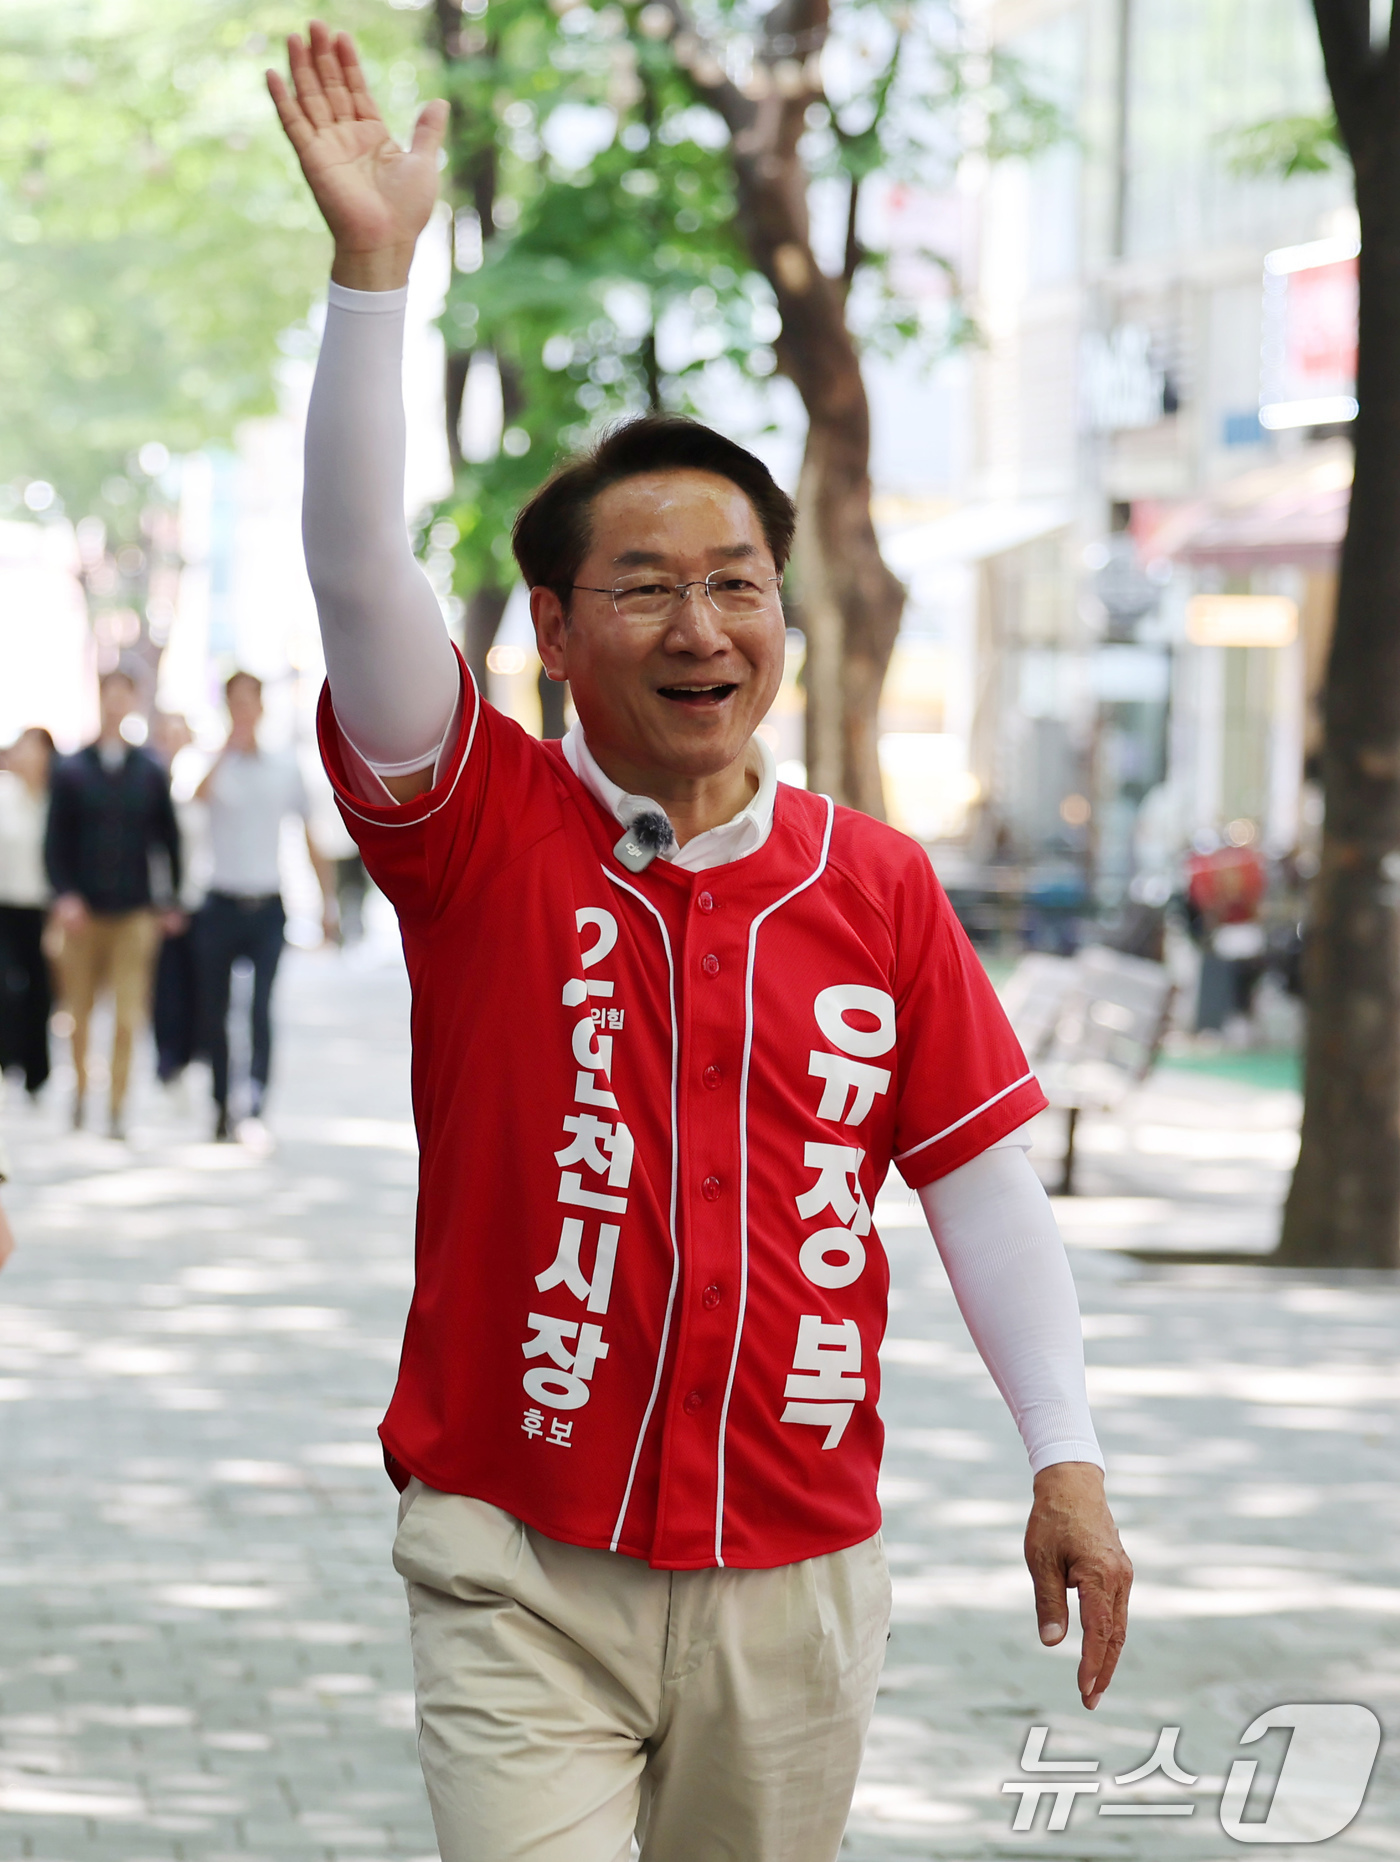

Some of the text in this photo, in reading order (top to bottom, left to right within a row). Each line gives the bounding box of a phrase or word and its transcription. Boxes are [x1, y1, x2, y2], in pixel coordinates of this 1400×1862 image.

[521, 1016, 635, 1410] 인천시장
[780, 983, 897, 1450] 유정복
[520, 1407, 574, 1449] 후보
